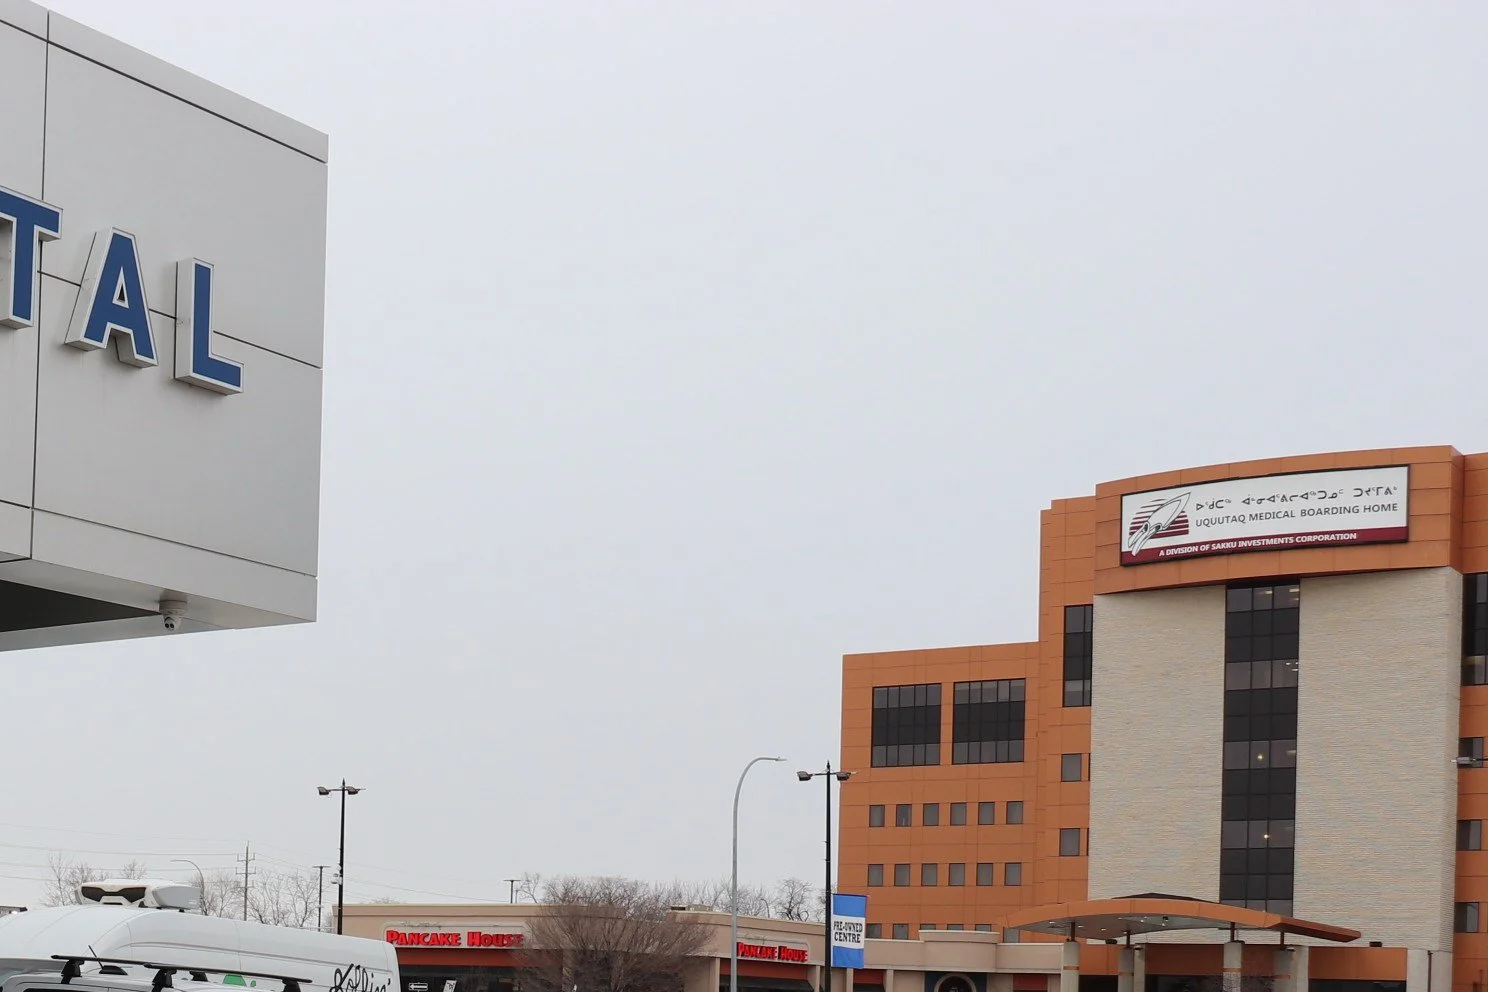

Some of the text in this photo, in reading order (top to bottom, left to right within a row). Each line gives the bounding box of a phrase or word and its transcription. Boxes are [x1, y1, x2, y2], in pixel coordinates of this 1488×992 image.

[1195, 503, 1398, 528] UQUUTAQ MEDICAL BOARDING HOME
[1166, 546, 1199, 556] DIVISION
[1211, 541, 1237, 551] SAKKU
[1238, 537, 1294, 548] INVESTMENTS
[1295, 533, 1357, 543] CORPORATION
[833, 921, 863, 933] PRE-OWNED
[386, 930, 524, 947] PANCAKE HOUSE
[834, 932, 861, 943] CENTRE
[737, 942, 808, 962] PANCAKE HOUSE
